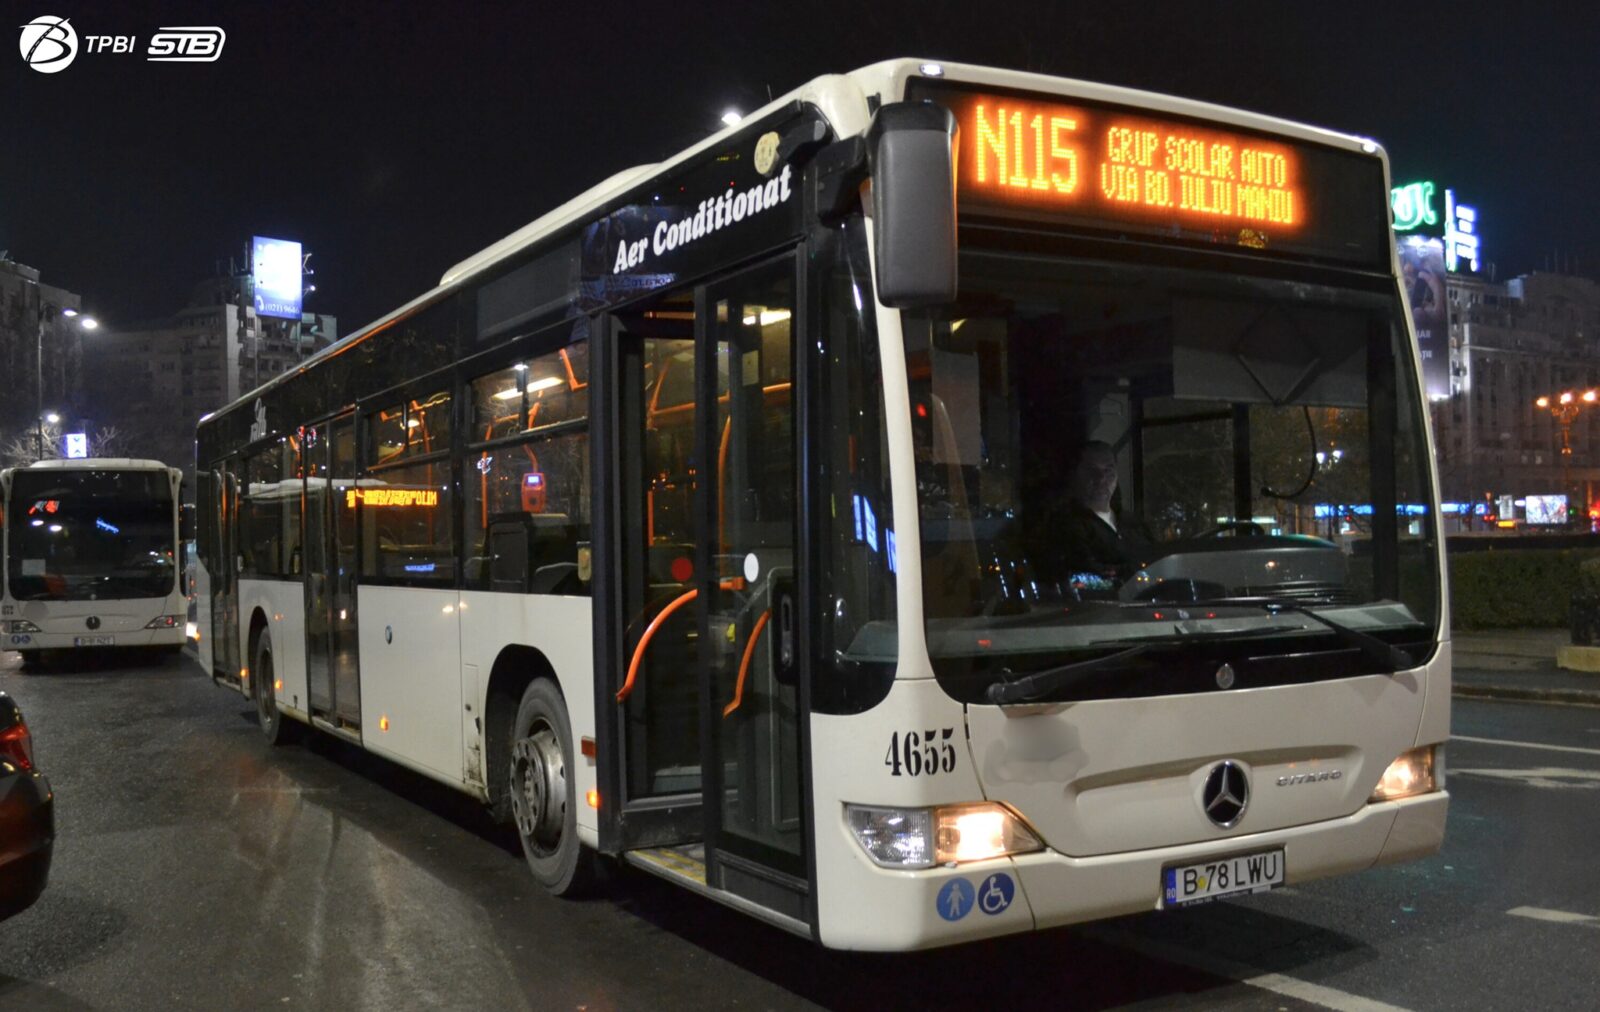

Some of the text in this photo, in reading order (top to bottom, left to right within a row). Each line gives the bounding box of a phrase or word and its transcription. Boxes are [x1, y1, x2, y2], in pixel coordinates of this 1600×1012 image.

[975, 104, 1077, 195] N115
[1108, 127, 1286, 187] GRUP SCOLAR AUTO
[613, 163, 792, 274] Aer Conditionat
[1101, 163, 1138, 202] VIA
[1180, 175, 1232, 215] IULIU
[1237, 184, 1292, 224] MANIU
[885, 728, 957, 777] 4655
[1276, 769, 1342, 787] CITARO
